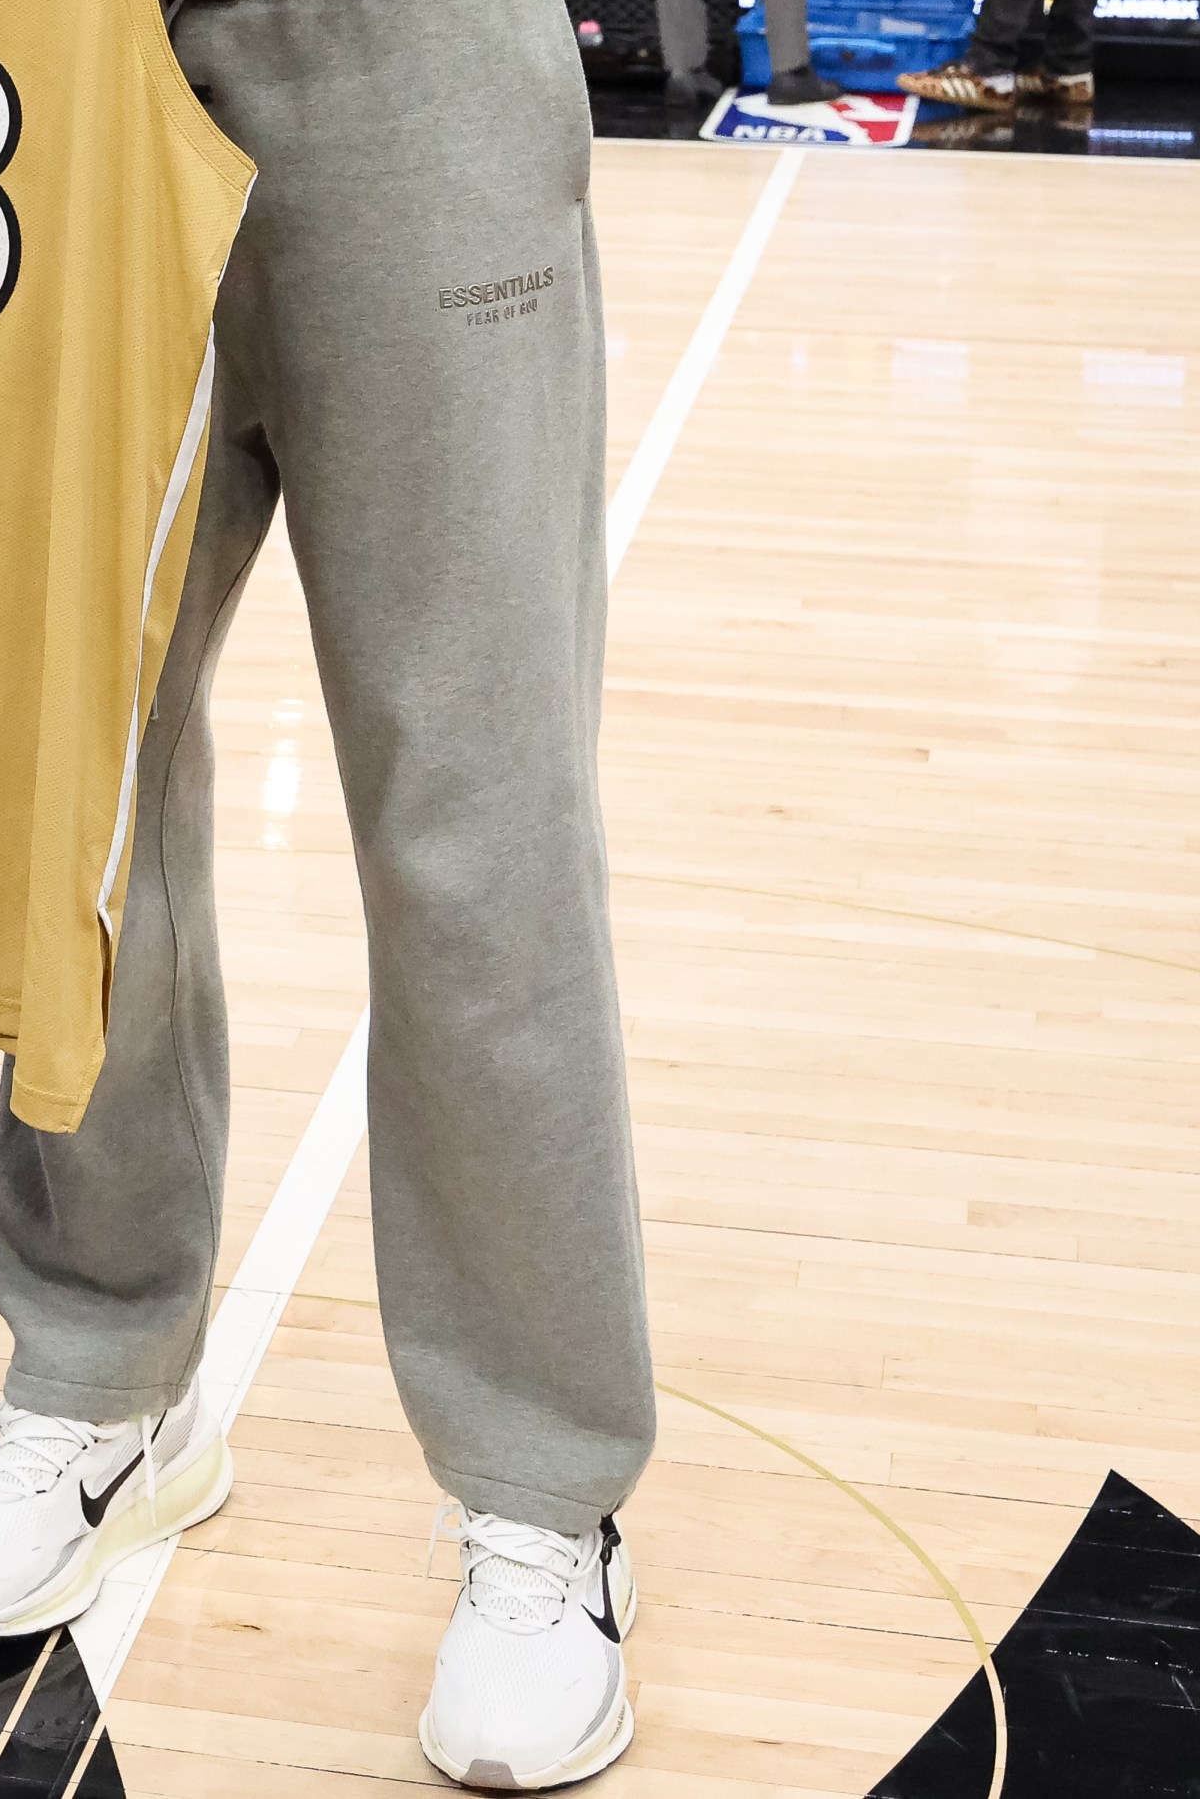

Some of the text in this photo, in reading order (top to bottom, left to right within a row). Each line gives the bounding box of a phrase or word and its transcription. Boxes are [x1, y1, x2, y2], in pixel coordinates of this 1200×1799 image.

[732, 124, 817, 142] NBA
[438, 265, 554, 309] ESSENTIALS
[466, 308, 500, 327] FEAR
[504, 304, 517, 320] OF
